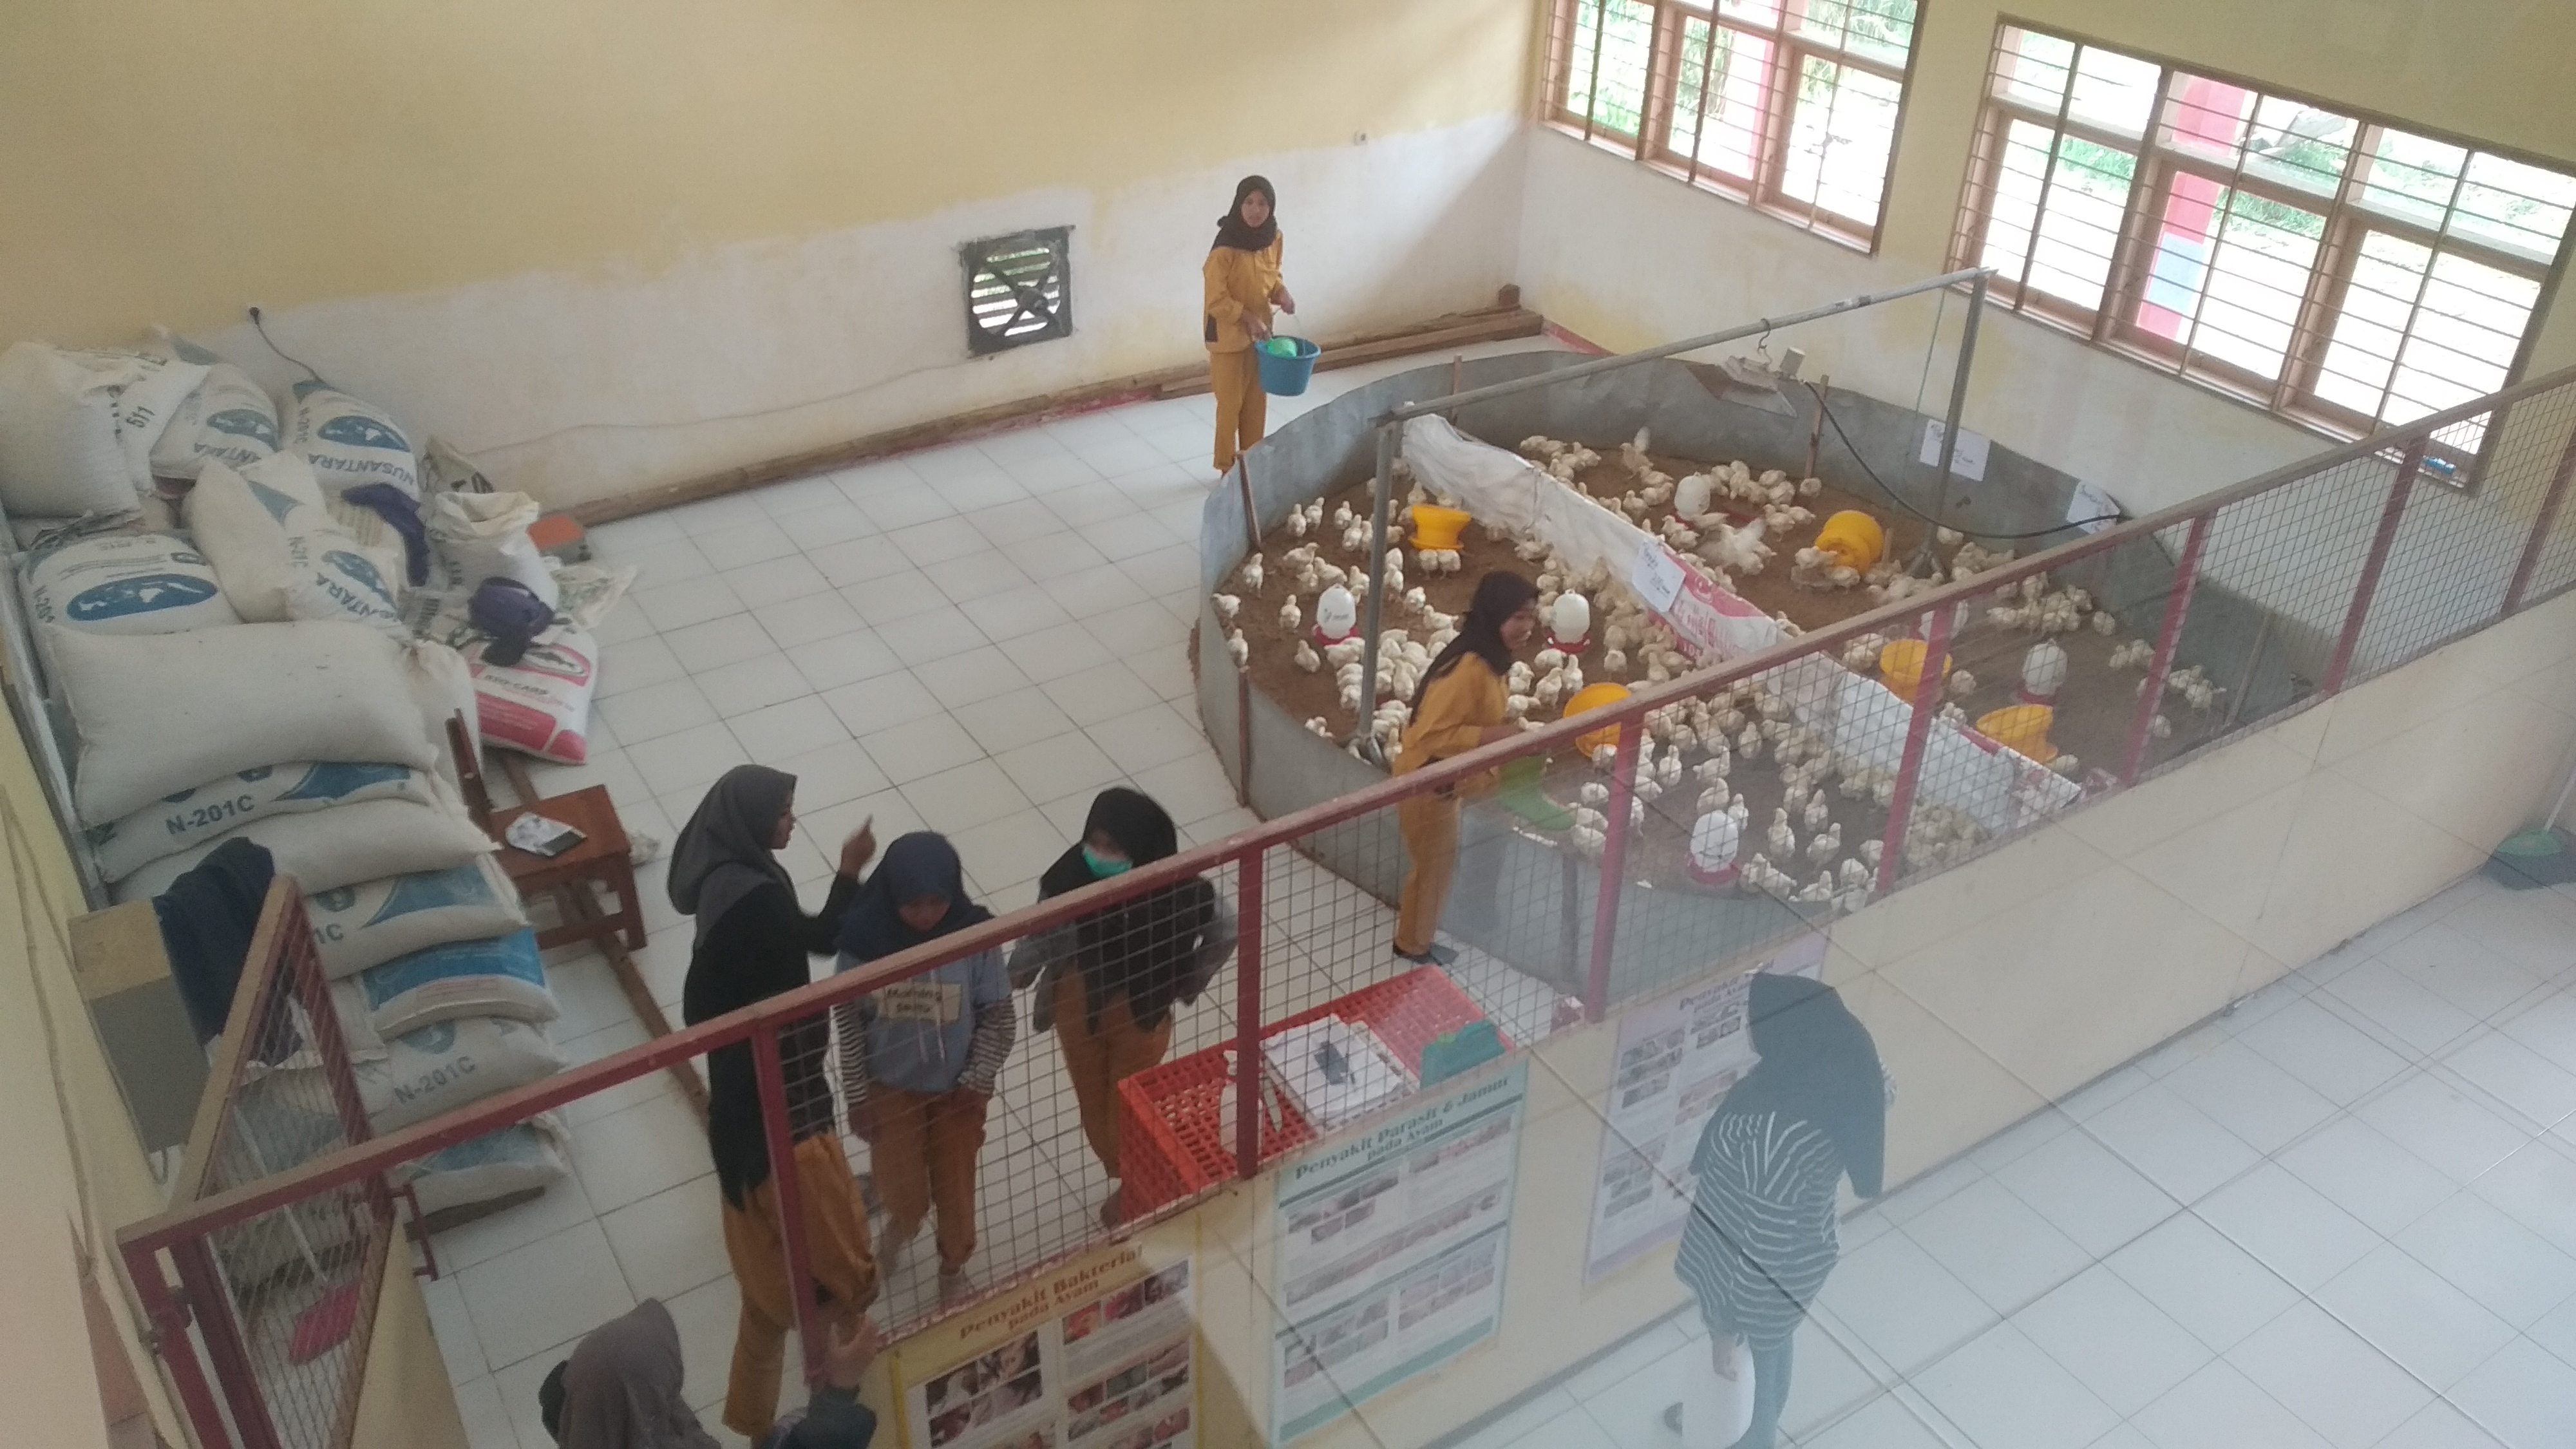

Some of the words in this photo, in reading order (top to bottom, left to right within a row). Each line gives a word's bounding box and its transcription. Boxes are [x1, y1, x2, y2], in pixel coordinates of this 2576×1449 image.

[308, 453, 413, 485] NUSANTARA
[166, 794, 255, 835] N-201C
[394, 1056, 475, 1104] N-201C
[1296, 1137, 1372, 1179] Penyakit
[1378, 1108, 1437, 1142] Parasit
[1367, 1138, 1402, 1160] pada
[1408, 1119, 1443, 1141] Ayam
[960, 1287, 1046, 1340] Penyakit
[1053, 1244, 1142, 1294] Bakterial
[1009, 1303, 1048, 1330] pada
[1055, 1279, 1099, 1305] Ayam
